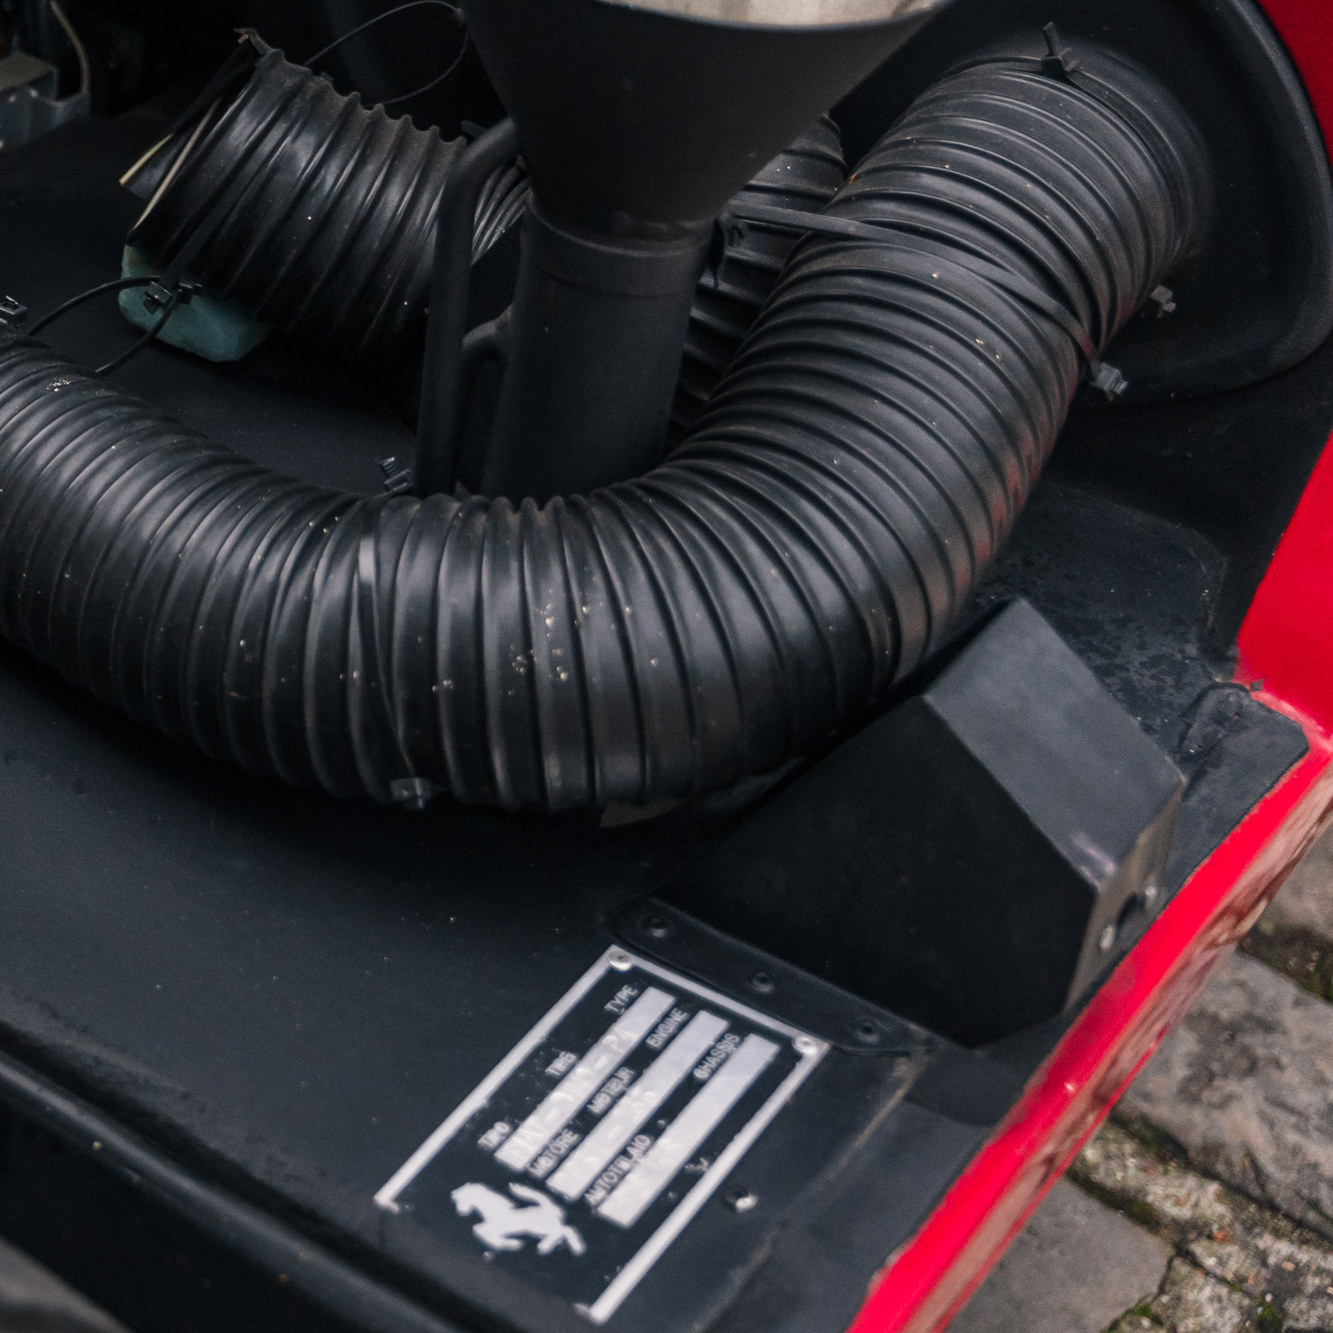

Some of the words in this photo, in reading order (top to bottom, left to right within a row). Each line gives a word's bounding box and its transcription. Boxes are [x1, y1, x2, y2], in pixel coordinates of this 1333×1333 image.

[606, 984, 637, 1013] TYPE
[693, 1033, 740, 1079] CHASSIS
[530, 1129, 578, 1177] MOTORE
[646, 1010, 687, 1047] ENGINE
